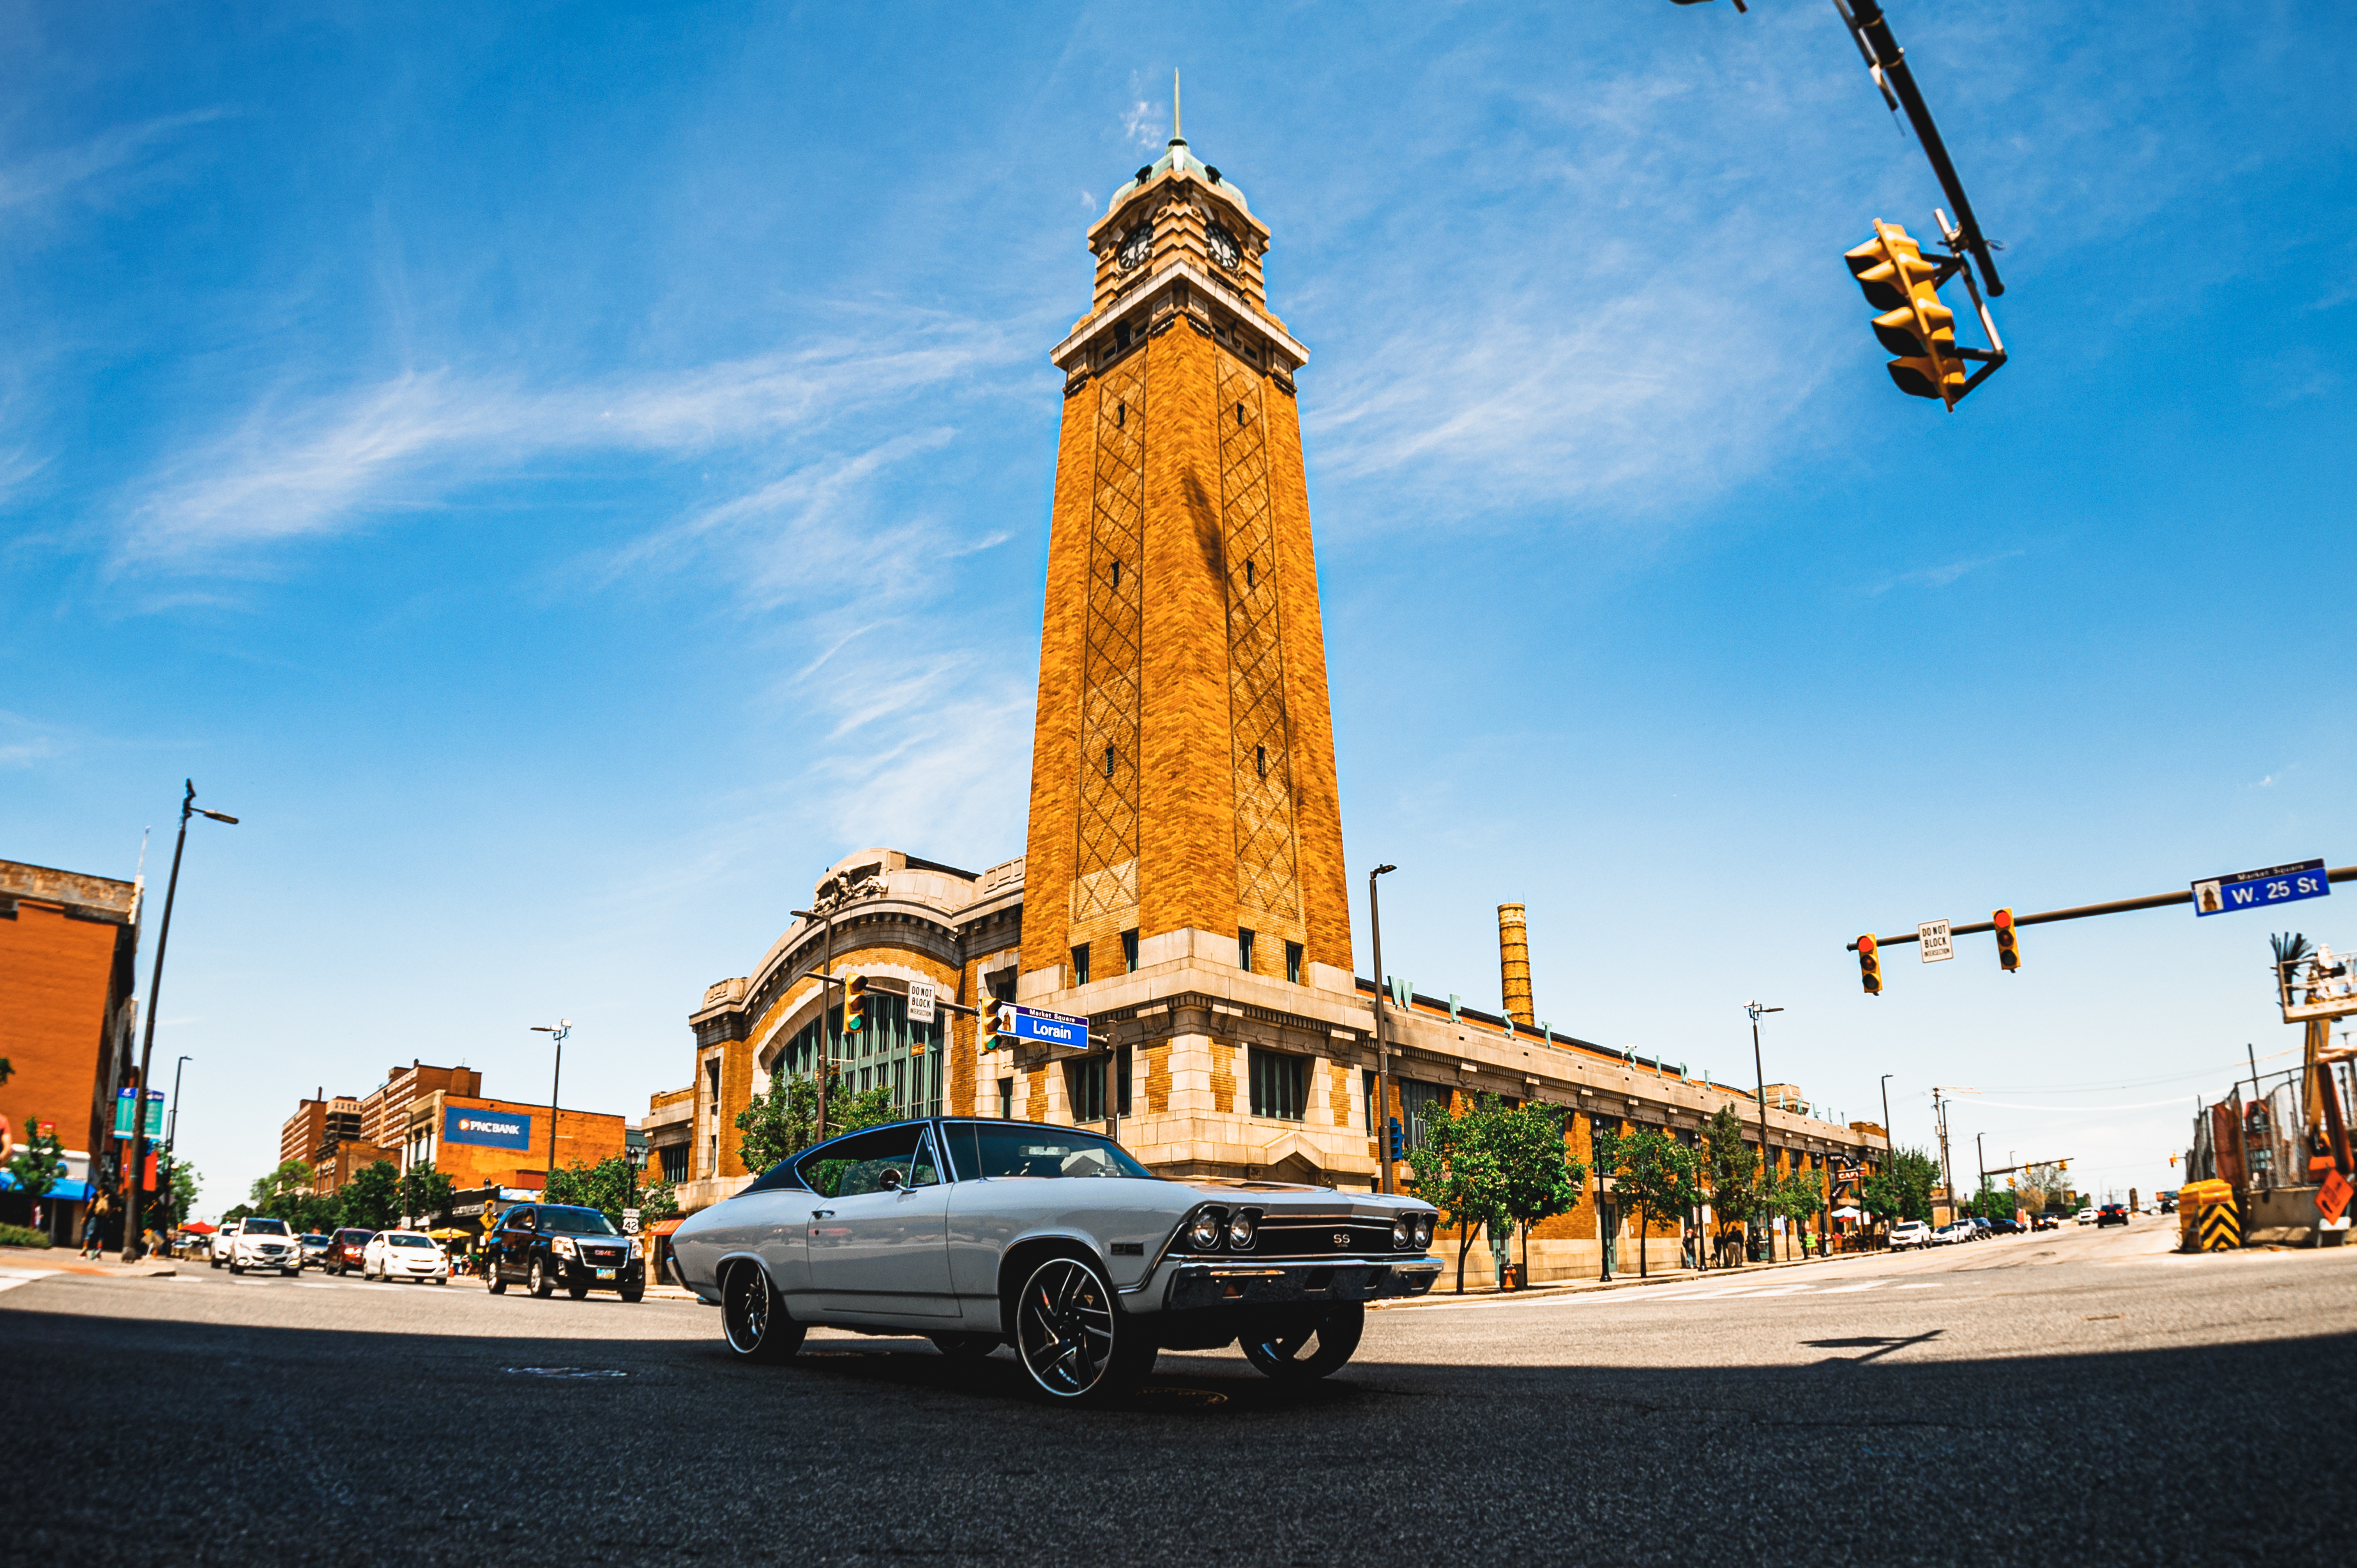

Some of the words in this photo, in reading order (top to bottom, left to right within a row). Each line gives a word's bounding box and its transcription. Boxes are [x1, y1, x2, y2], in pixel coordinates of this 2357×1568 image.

[2237, 870, 2269, 880] Market
[2273, 865, 2304, 874] Square
[2231, 887, 2260, 904] W.
[2266, 881, 2290, 899] 25
[2297, 877, 2319, 893] St
[1922, 927, 1931, 937] DO
[1933, 925, 1945, 935] NOT
[1924, 937, 1947, 948] BLOCK
[912, 986, 919, 995] DO
[921, 988, 932, 997] NOT
[912, 997, 930, 1008] BLOCK
[1029, 1009, 1051, 1019] Market
[1054, 1014, 1075, 1023] Square
[1387, 975, 1553, 1046] WEST
[1034, 1020, 1071, 1040] Lorain
[625, 1221, 637, 1230] 42
[1334, 1234, 1350, 1243] SS
